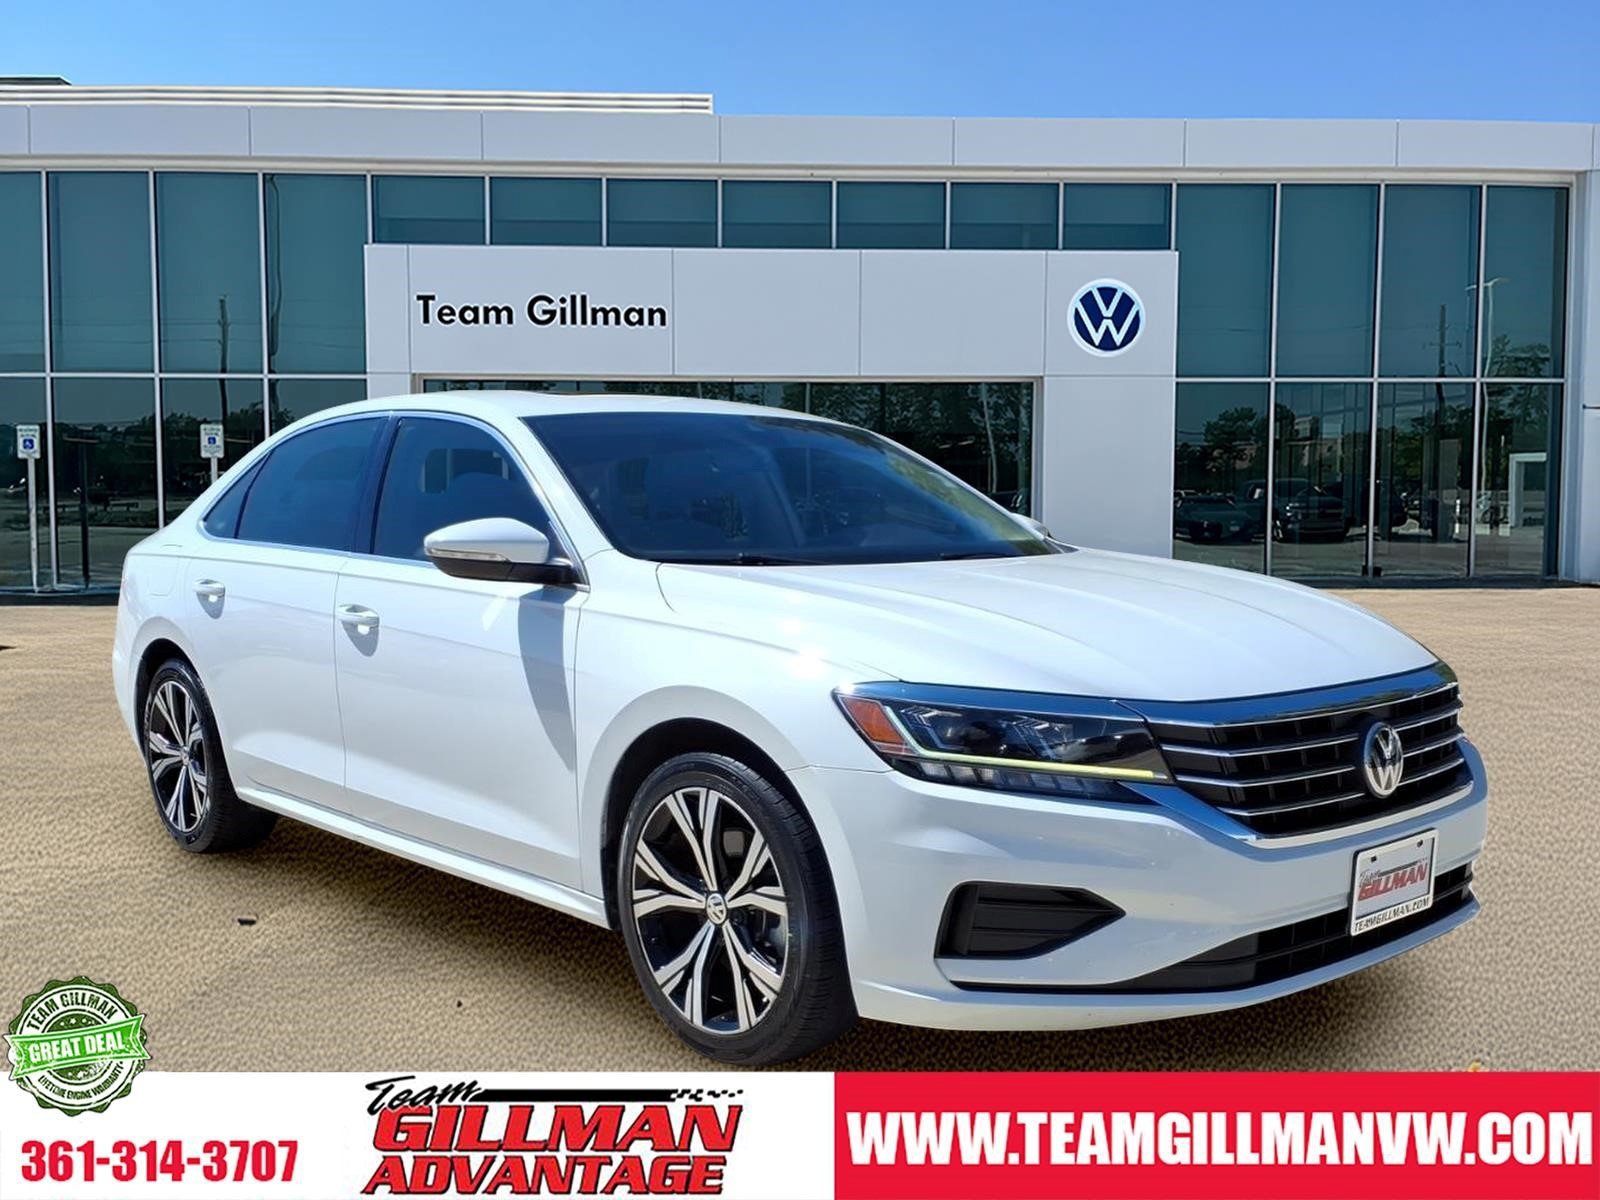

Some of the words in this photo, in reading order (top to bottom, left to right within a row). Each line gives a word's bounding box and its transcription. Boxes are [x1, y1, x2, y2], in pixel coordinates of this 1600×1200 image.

[416, 294, 514, 325] Team
[527, 294, 667, 327] Gillman
[1357, 862, 1428, 901] GILLMAN
